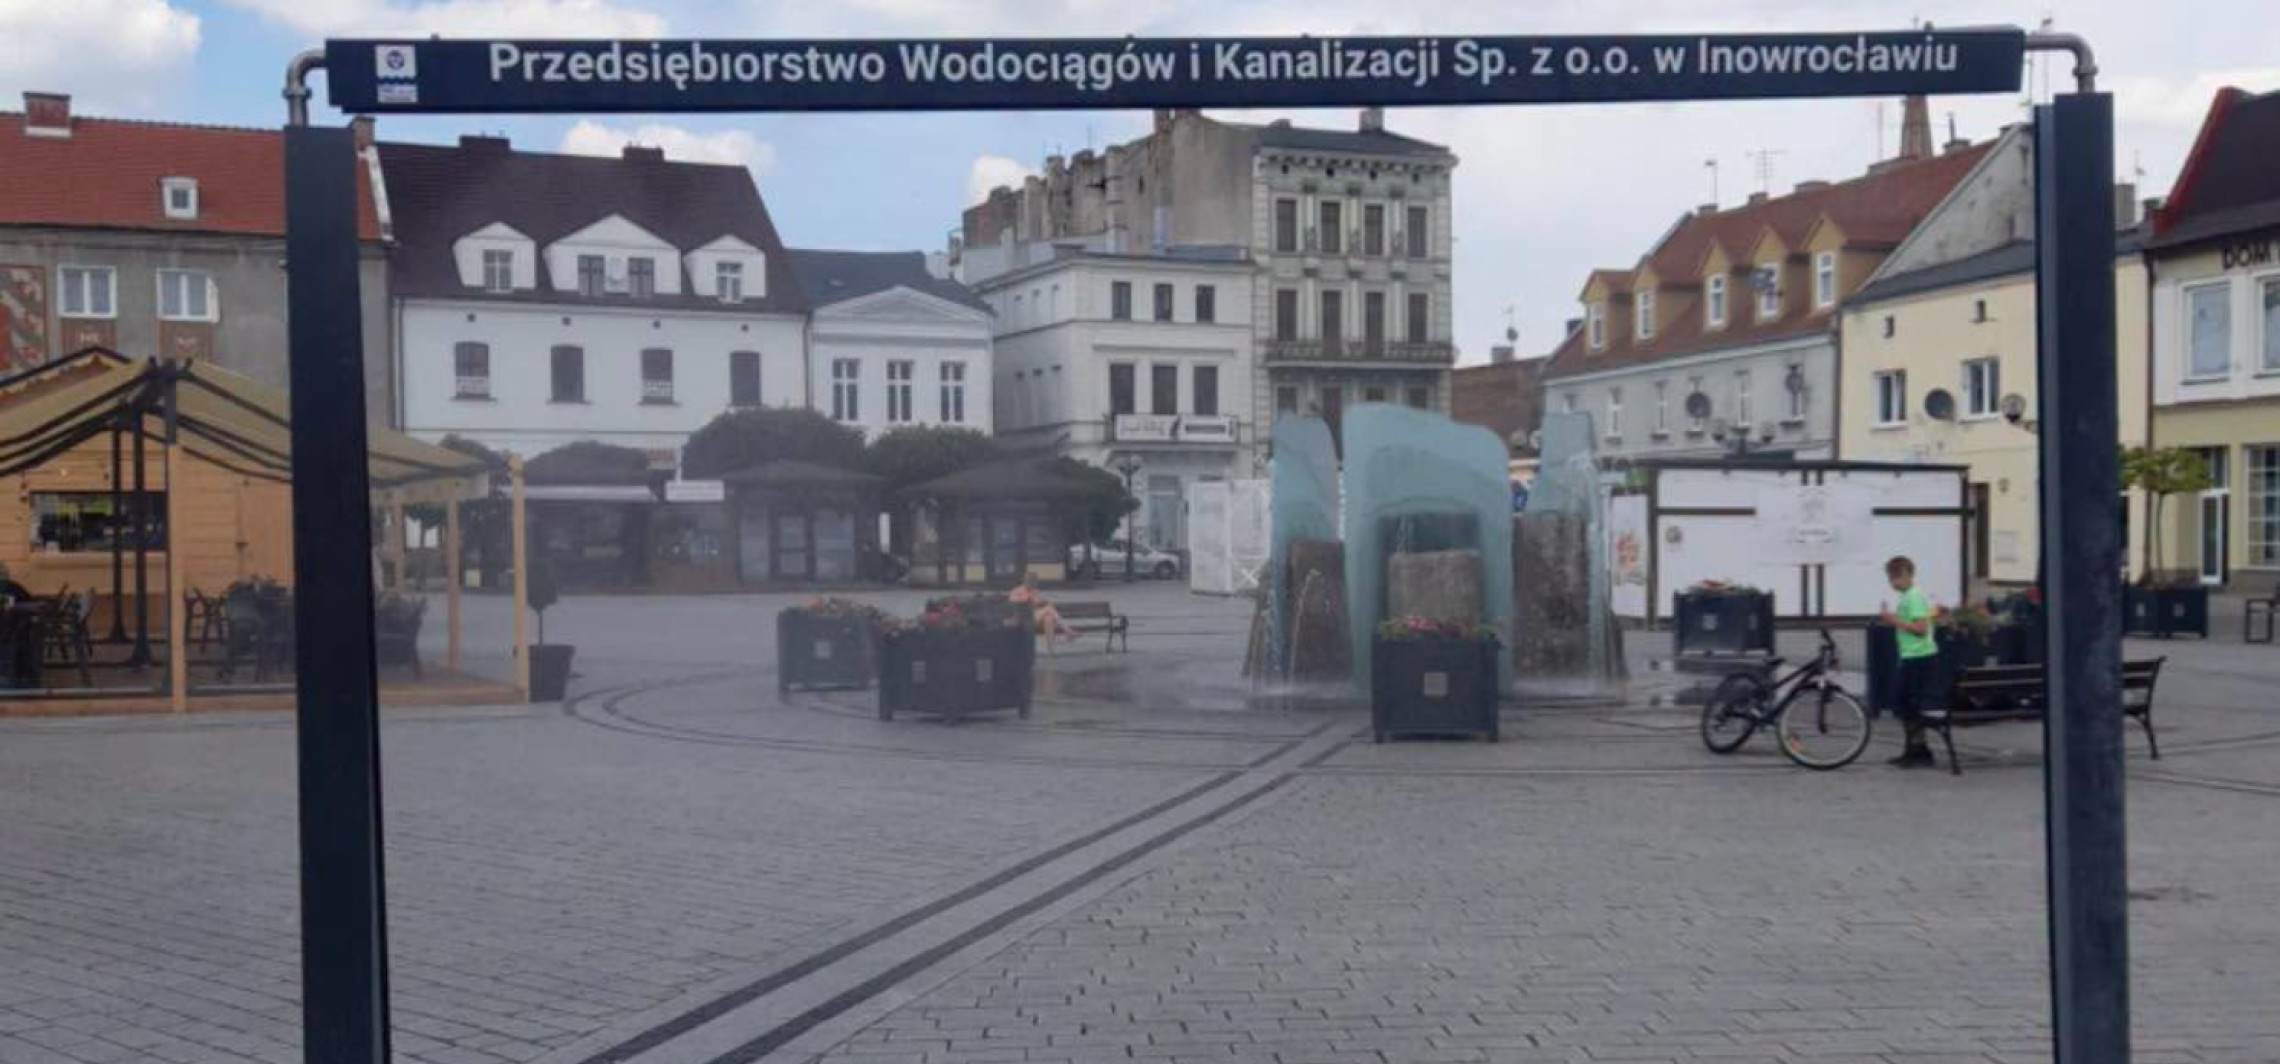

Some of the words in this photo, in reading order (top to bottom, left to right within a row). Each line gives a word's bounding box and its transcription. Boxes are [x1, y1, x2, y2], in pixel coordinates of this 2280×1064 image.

[1190, 42, 1200, 80] i
[1213, 39, 1440, 87] Kanalizacji
[1453, 38, 1517, 85] Sp.
[1531, 46, 1553, 75] z
[1565, 46, 1640, 75] o.o.
[1653, 46, 1686, 74] w
[1698, 35, 1958, 73] Inowrocławiu
[2223, 241, 2271, 270] DOM
